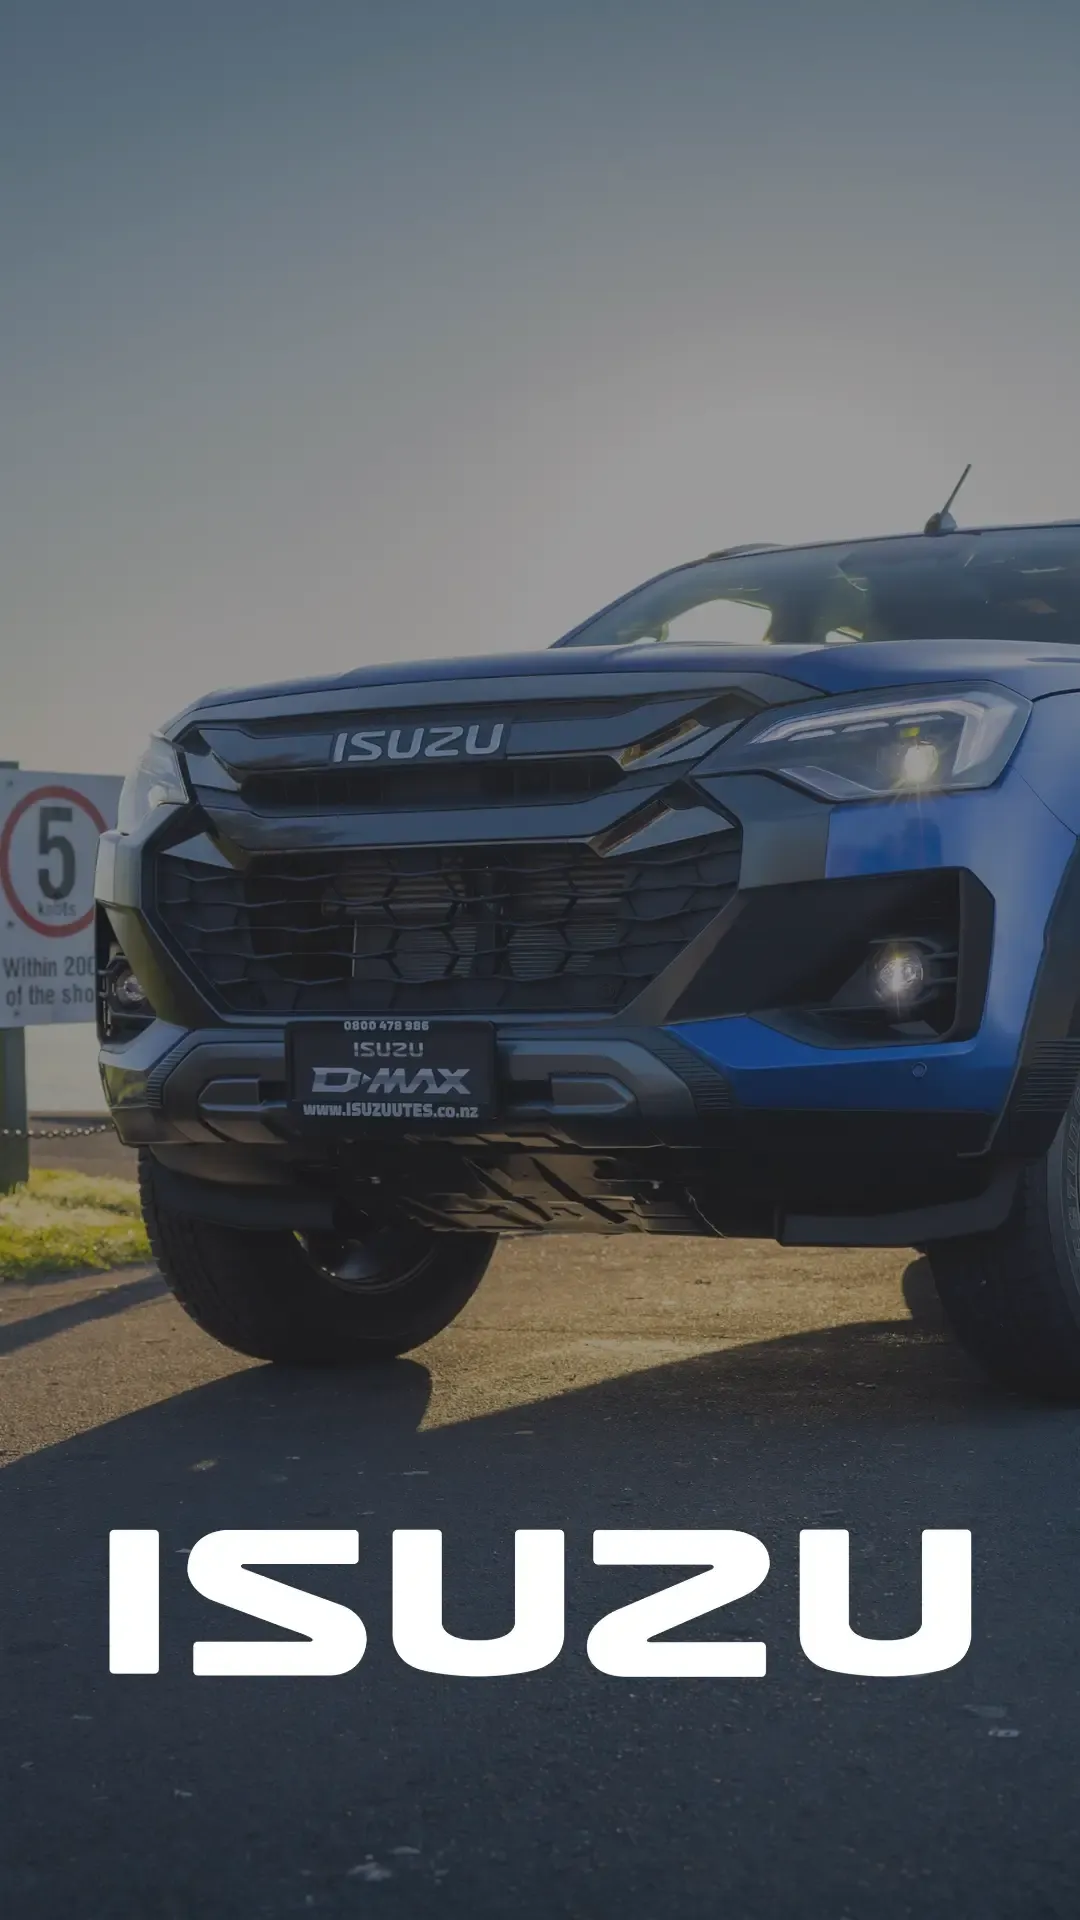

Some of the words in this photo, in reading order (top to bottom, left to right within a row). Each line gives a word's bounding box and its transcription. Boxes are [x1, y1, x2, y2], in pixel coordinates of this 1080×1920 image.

[333, 723, 504, 763] ISUZU
[37, 806, 76, 900] 5
[2, 955, 58, 979] Within
[6, 984, 23, 1007] of
[28, 984, 55, 1006] the
[343, 1020, 376, 1031] 0800
[379, 1020, 402, 1031] 478
[404, 1020, 430, 1031] 986
[353, 1042, 424, 1058] ISUZU
[302, 1102, 479, 1119] www.ISUZUUTES.co.nz
